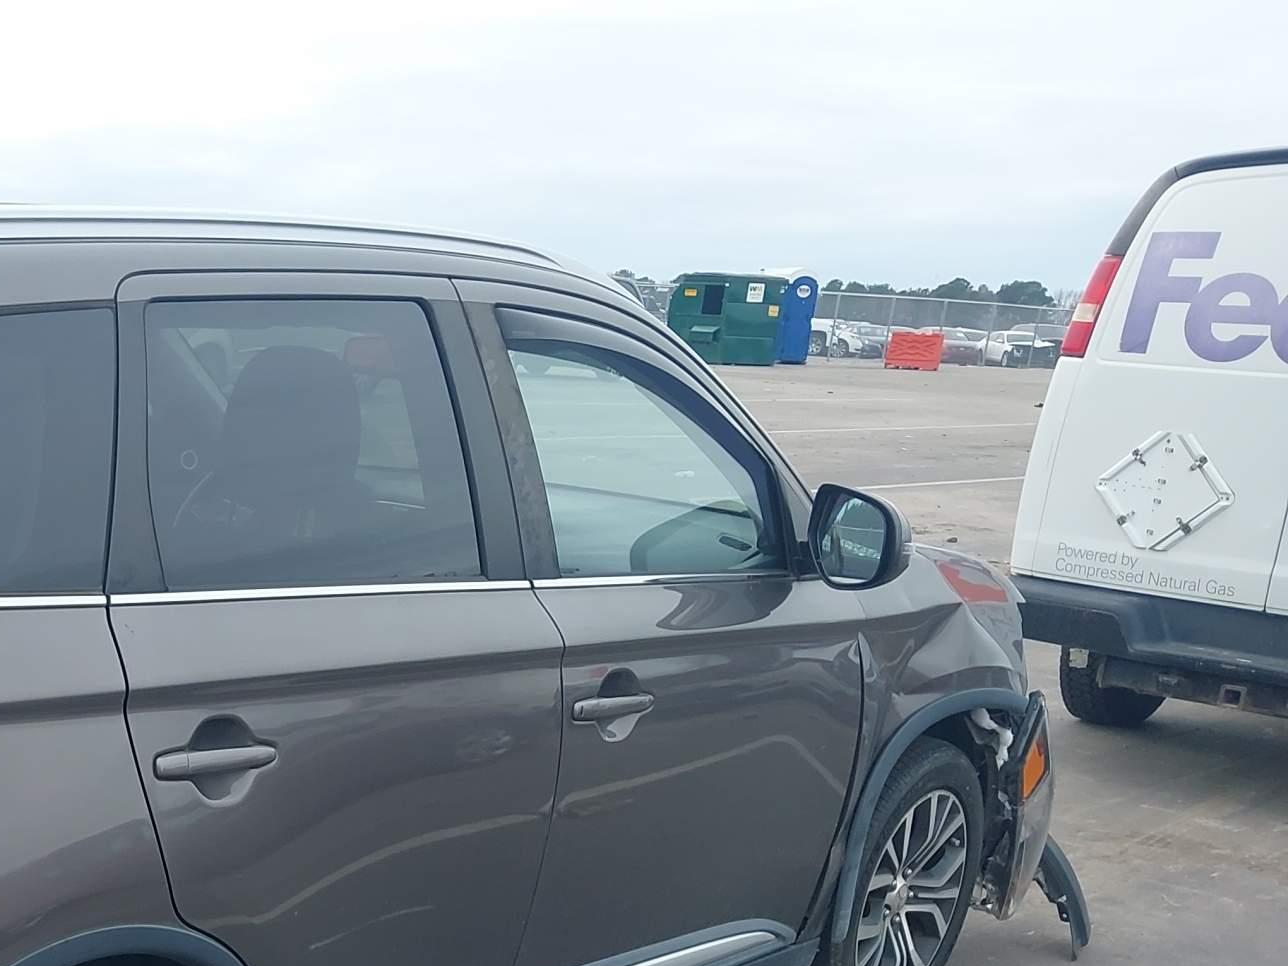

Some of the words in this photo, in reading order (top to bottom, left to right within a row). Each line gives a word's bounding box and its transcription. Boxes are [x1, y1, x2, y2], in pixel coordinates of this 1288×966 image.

[1119, 231, 1288, 365] Fe
[1056, 542, 1117, 564] Powered
[1120, 552, 1138, 568] by
[1055, 558, 1143, 583] Compressed
[1148, 572, 1200, 592] Natural
[1206, 580, 1236, 597] Gas
